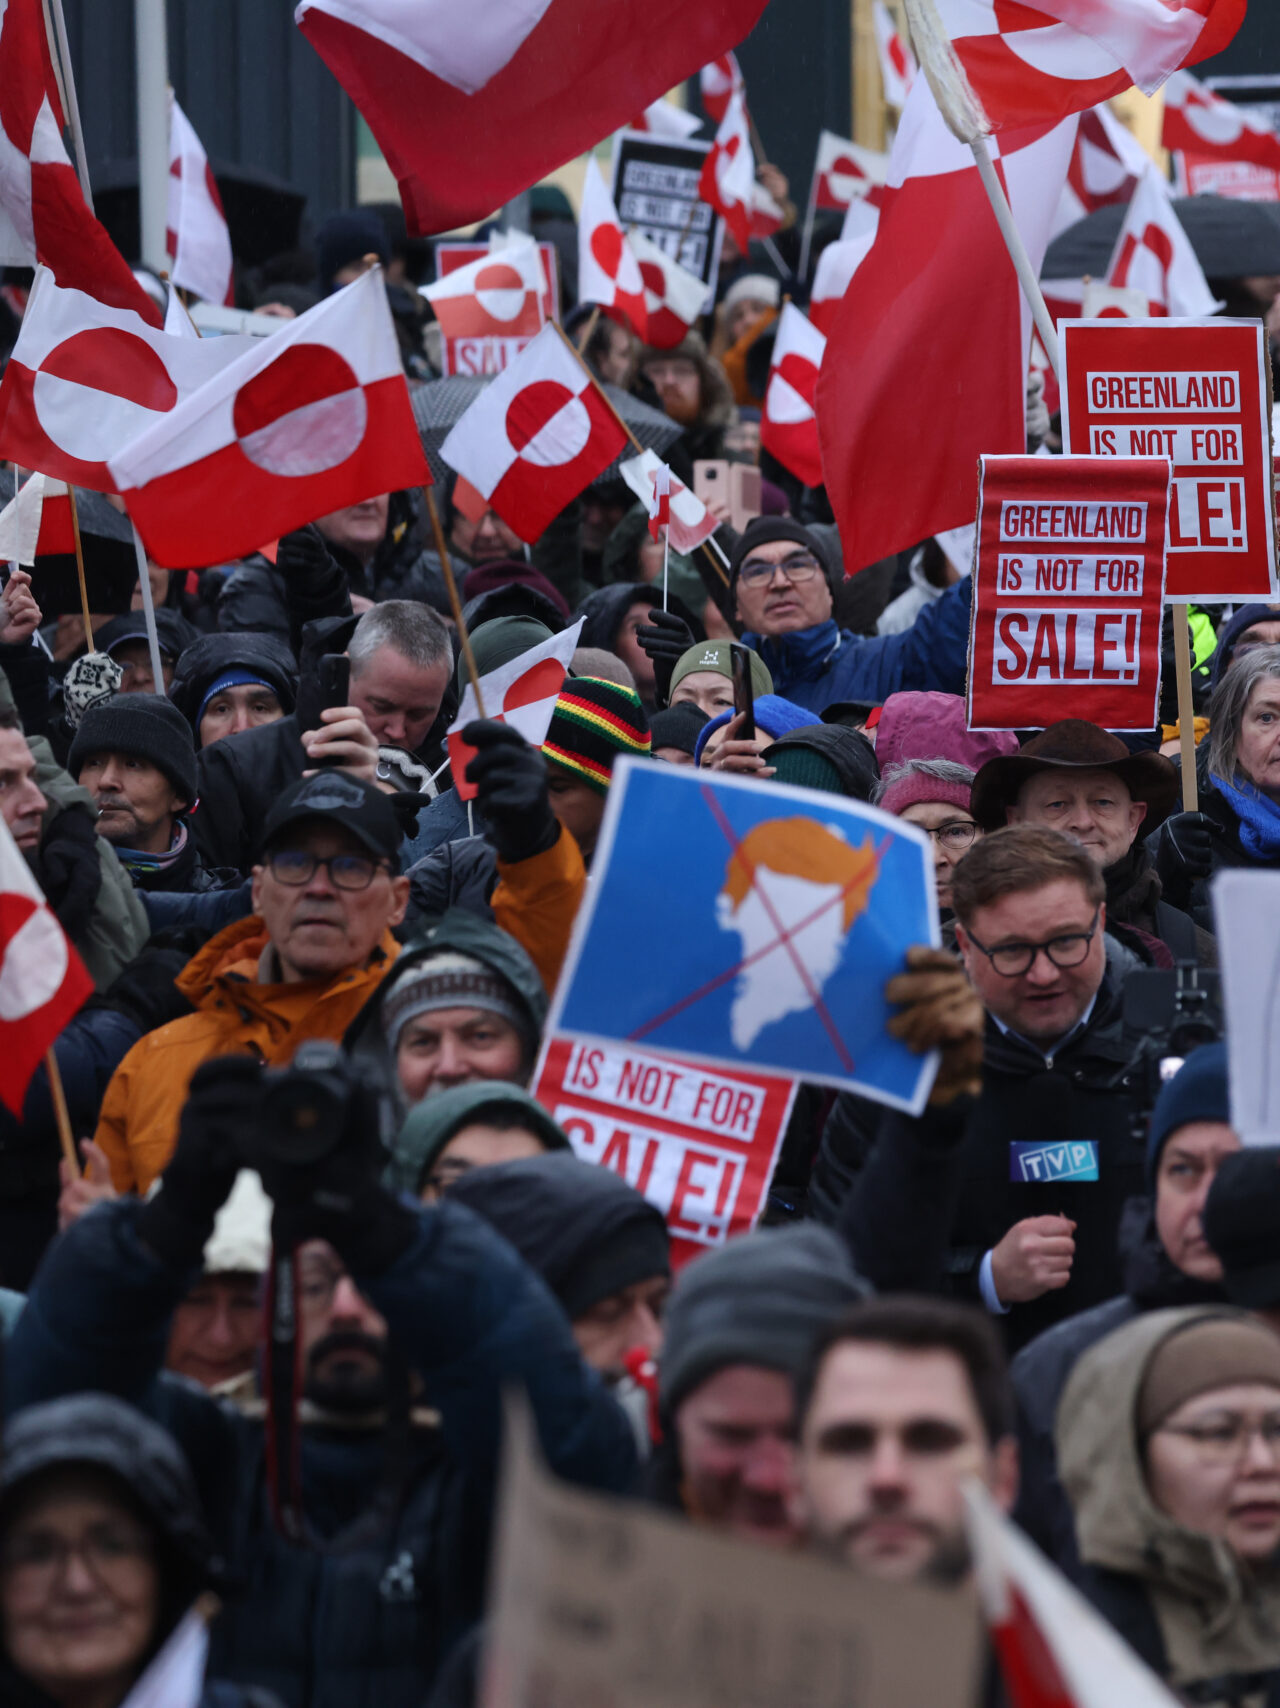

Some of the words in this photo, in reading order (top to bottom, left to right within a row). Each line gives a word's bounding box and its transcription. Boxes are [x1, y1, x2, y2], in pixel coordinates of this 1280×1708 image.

[1091, 376, 1236, 409] GREENLAND
[1094, 430, 1116, 455] IS
[1130, 430, 1177, 461] NOT
[1191, 429, 1238, 461] FOR
[1004, 505, 1142, 538] GREENLAND
[1169, 482, 1243, 547] LE!
[1001, 558, 1023, 591] IS
[1035, 559, 1083, 592] NOT
[1094, 559, 1139, 592] FOR
[997, 612, 1137, 680] SALE!
[572, 1045, 605, 1090] IS
[615, 1059, 683, 1111] NOT
[692, 1081, 755, 1132] FOR
[1025, 1144, 1087, 1179] TVP
